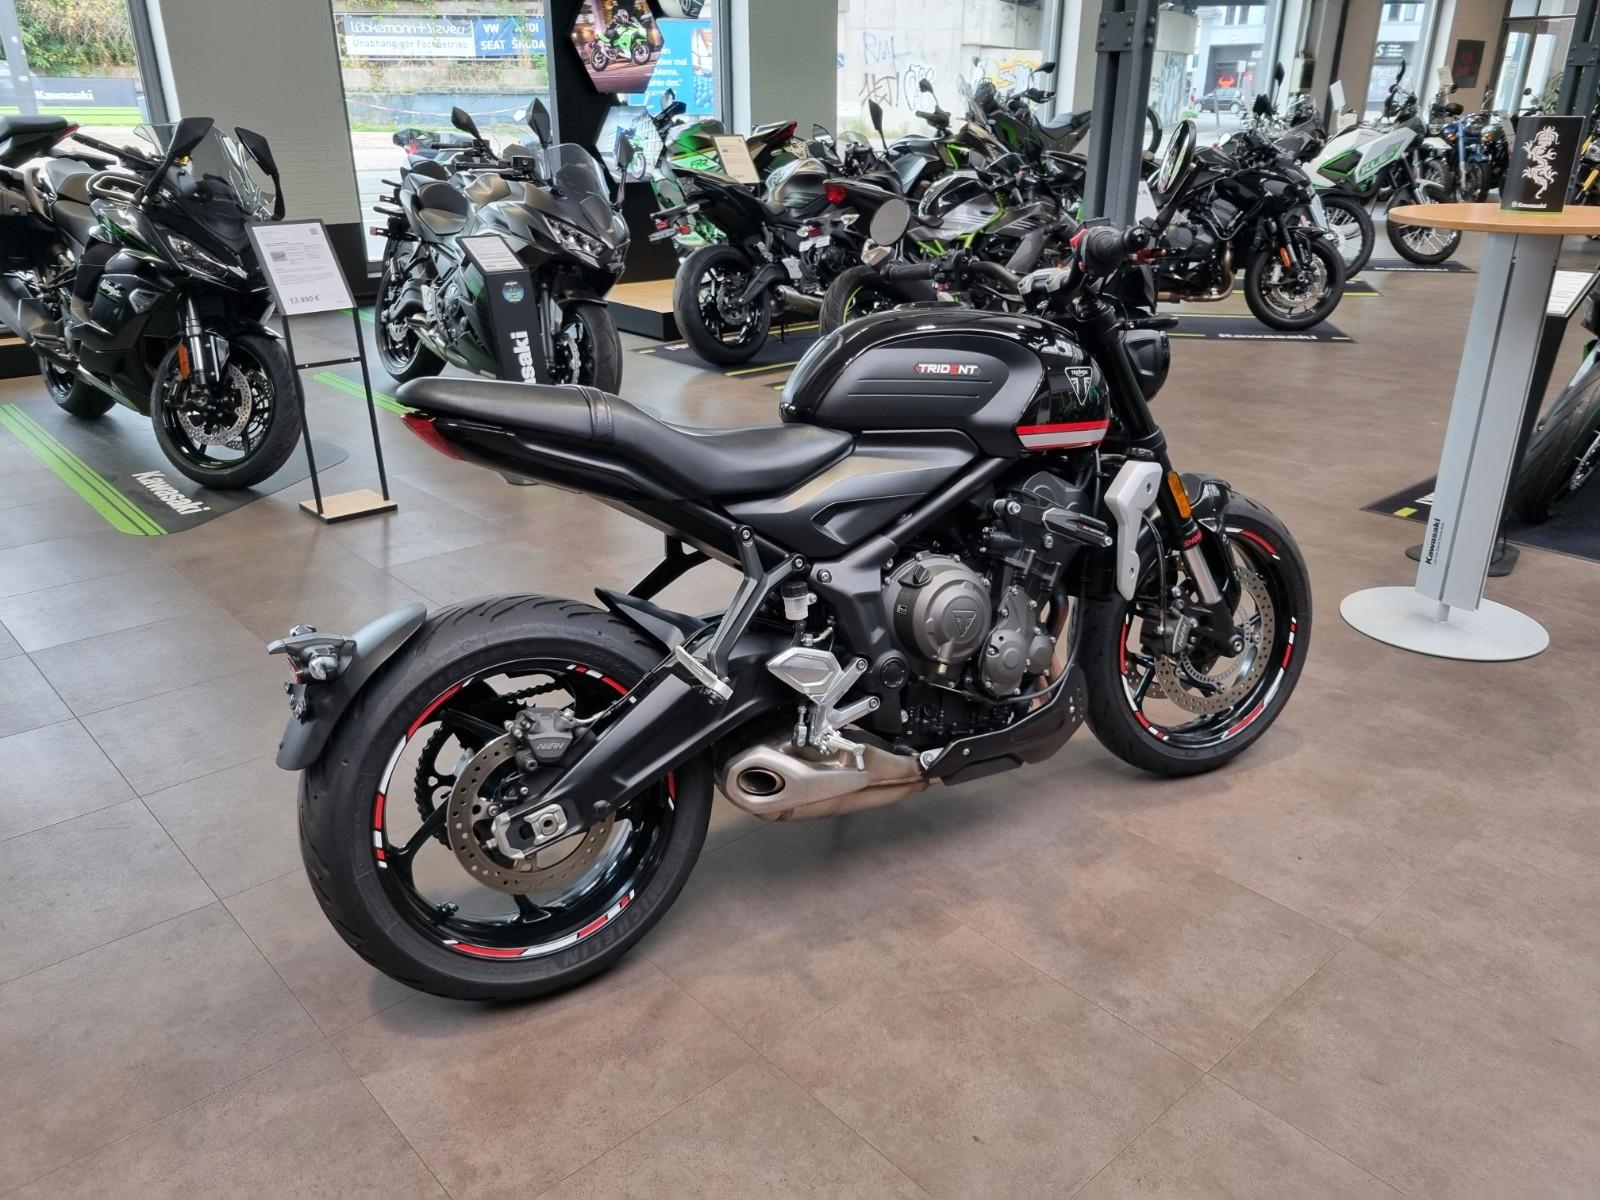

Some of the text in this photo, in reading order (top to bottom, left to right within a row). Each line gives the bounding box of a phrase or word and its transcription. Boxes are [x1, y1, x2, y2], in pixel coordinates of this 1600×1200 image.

[483, 23, 499, 34] VW
[480, 40, 505, 50] SEAT
[34, 89, 95, 100] Kawasaki
[918, 363, 979, 376] TRIDENT
[131, 470, 212, 515] Kawasaki
[1425, 517, 1441, 565] Kawasaki
